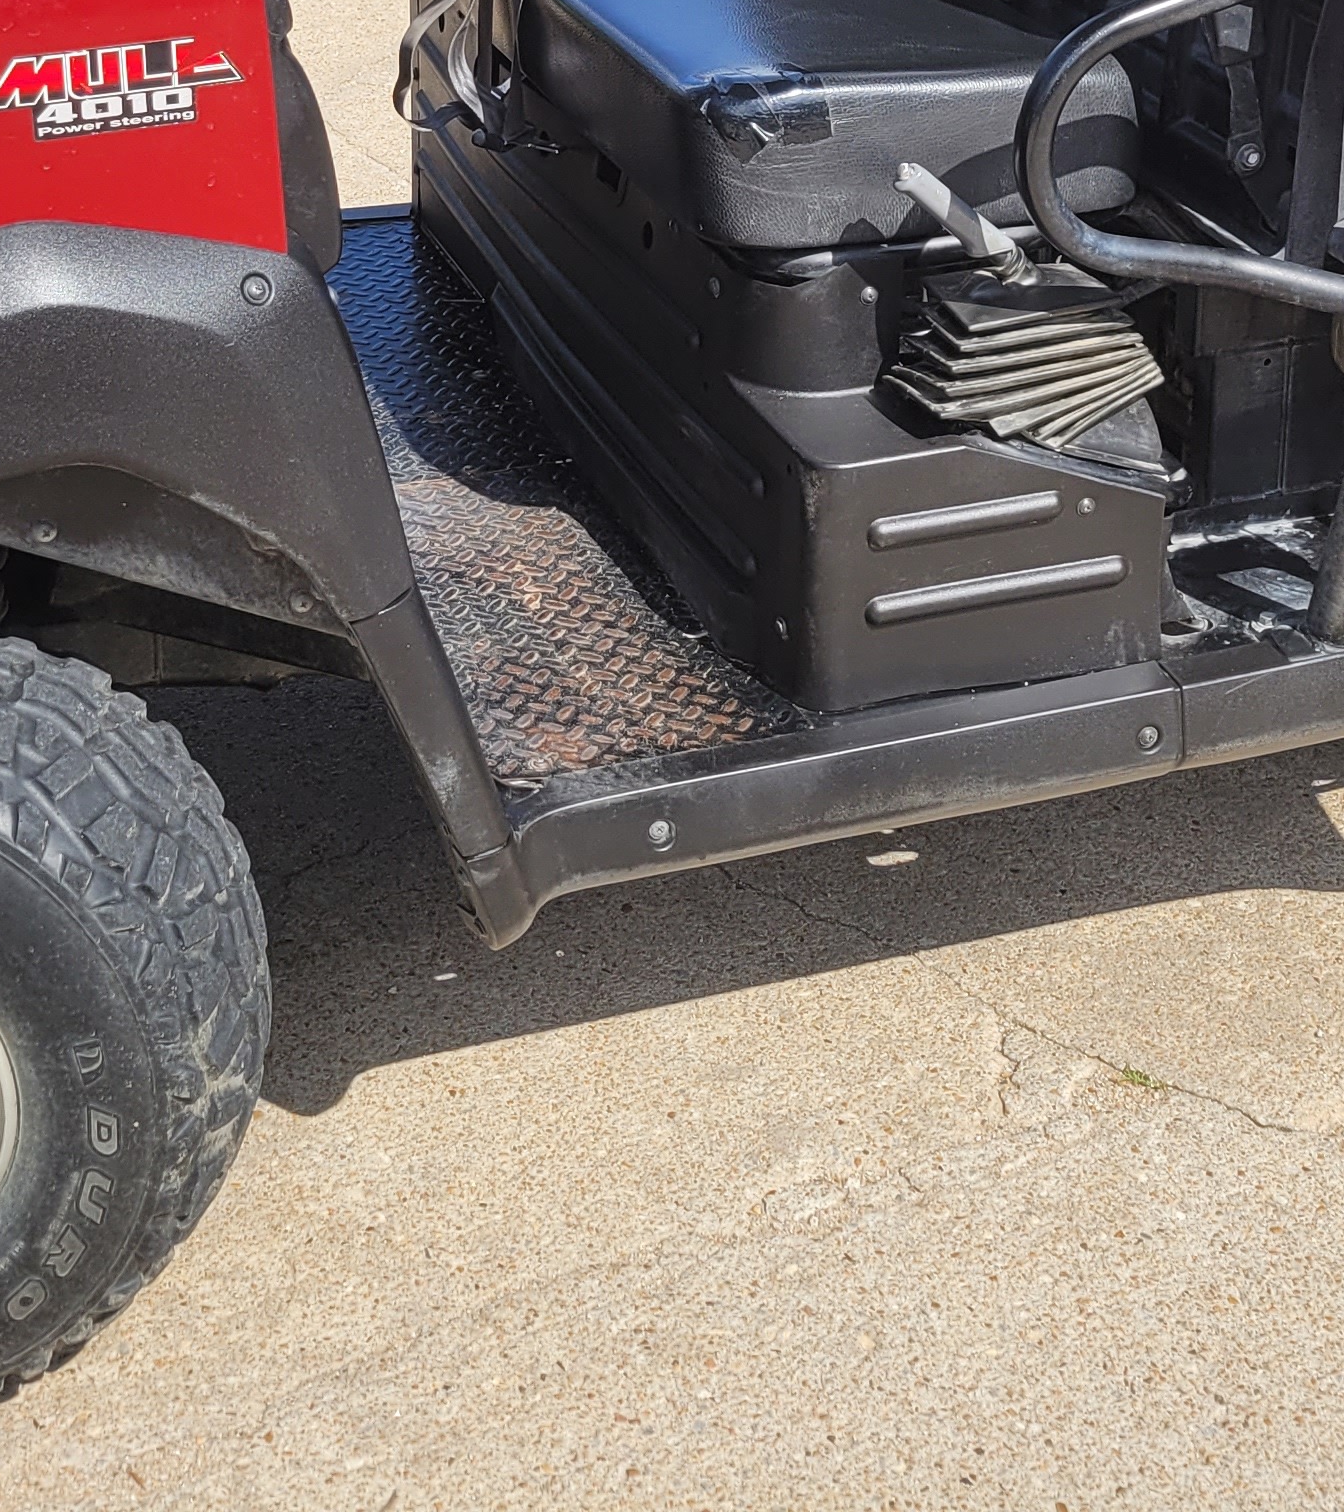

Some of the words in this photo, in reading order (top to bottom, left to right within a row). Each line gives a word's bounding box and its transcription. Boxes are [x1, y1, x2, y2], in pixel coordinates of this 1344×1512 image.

[36, 87, 194, 125] 4010
[37, 119, 105, 139] Power
[109, 107, 196, 130] steering
[5, 1103, 121, 1322] DURO
